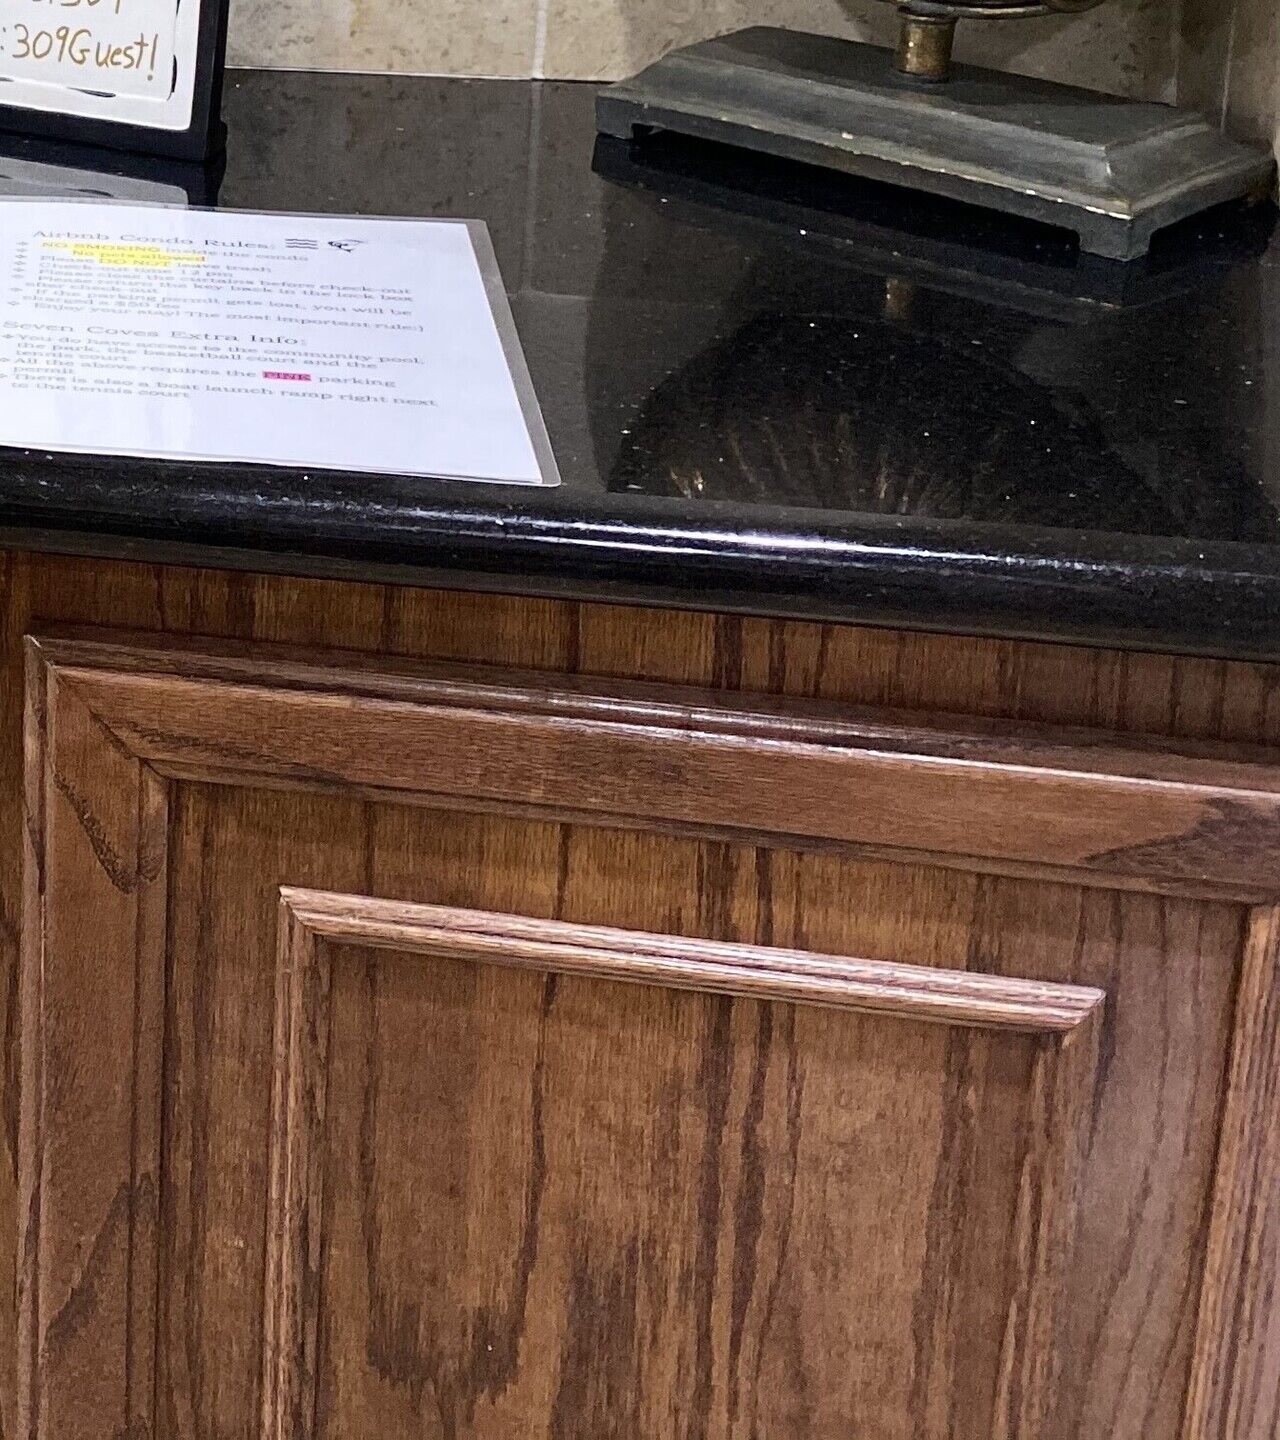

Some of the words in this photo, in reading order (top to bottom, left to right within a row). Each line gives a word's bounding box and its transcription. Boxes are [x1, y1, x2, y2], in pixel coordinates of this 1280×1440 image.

[13, 23, 159, 82] 309Guest!
[33, 230, 109, 240] Airbnb
[120, 234, 193, 245] Condo
[41, 256, 94, 264] Please
[74, 243, 161, 253] SMOKING
[166, 248, 217, 256] inside
[140, 254, 206, 262] allowed
[39, 269, 93, 277] Please
[180, 277, 254, 285] curtains
[260, 280, 315, 289] before
[39, 276, 92, 284] Please
[97, 279, 152, 287] return
[194, 283, 222, 291] key
[231, 285, 272, 293] back
[337, 292, 374, 300] lock
[23, 295, 93, 305] charged
[87, 293, 156, 302] parking
[162, 296, 219, 304] permit
[313, 305, 346, 313] you
[390, 308, 412, 316] be
[34, 303, 84, 312] Enjoy
[277, 315, 368, 328] important
[3, 321, 73, 332] Seven
[87, 326, 159, 337] Coves
[171, 331, 238, 342] Extra
[251, 334, 305, 346] Info:
[16, 350, 73, 359] tennis
[79, 354, 129, 362] court
[18, 334, 51, 342] You
[88, 338, 130, 347] have
[136, 343, 197, 351] access
[263, 349, 371, 361] community
[18, 342, 45, 350] the
[108, 347, 137, 355] the
[144, 349, 241, 360] basketball
[246, 356, 296, 364] court
[303, 359, 339, 367] and
[347, 361, 378, 369] the
[13, 366, 73, 375] permit
[45, 359, 74, 367] the
[81, 362, 136, 370] above
[142, 366, 220, 375] requires
[227, 370, 256, 378] the
[319, 377, 396, 388] parking
[14, 373, 66, 382] There
[93, 378, 133, 386] also
[157, 382, 199, 391] boat
[206, 384, 273, 395] launch
[280, 390, 332, 400] ramp
[339, 393, 388, 403] right
[393, 397, 438, 407] next
[36, 383, 66, 391] the
[73, 386, 133, 395] tennis
[138, 390, 189, 398] court
